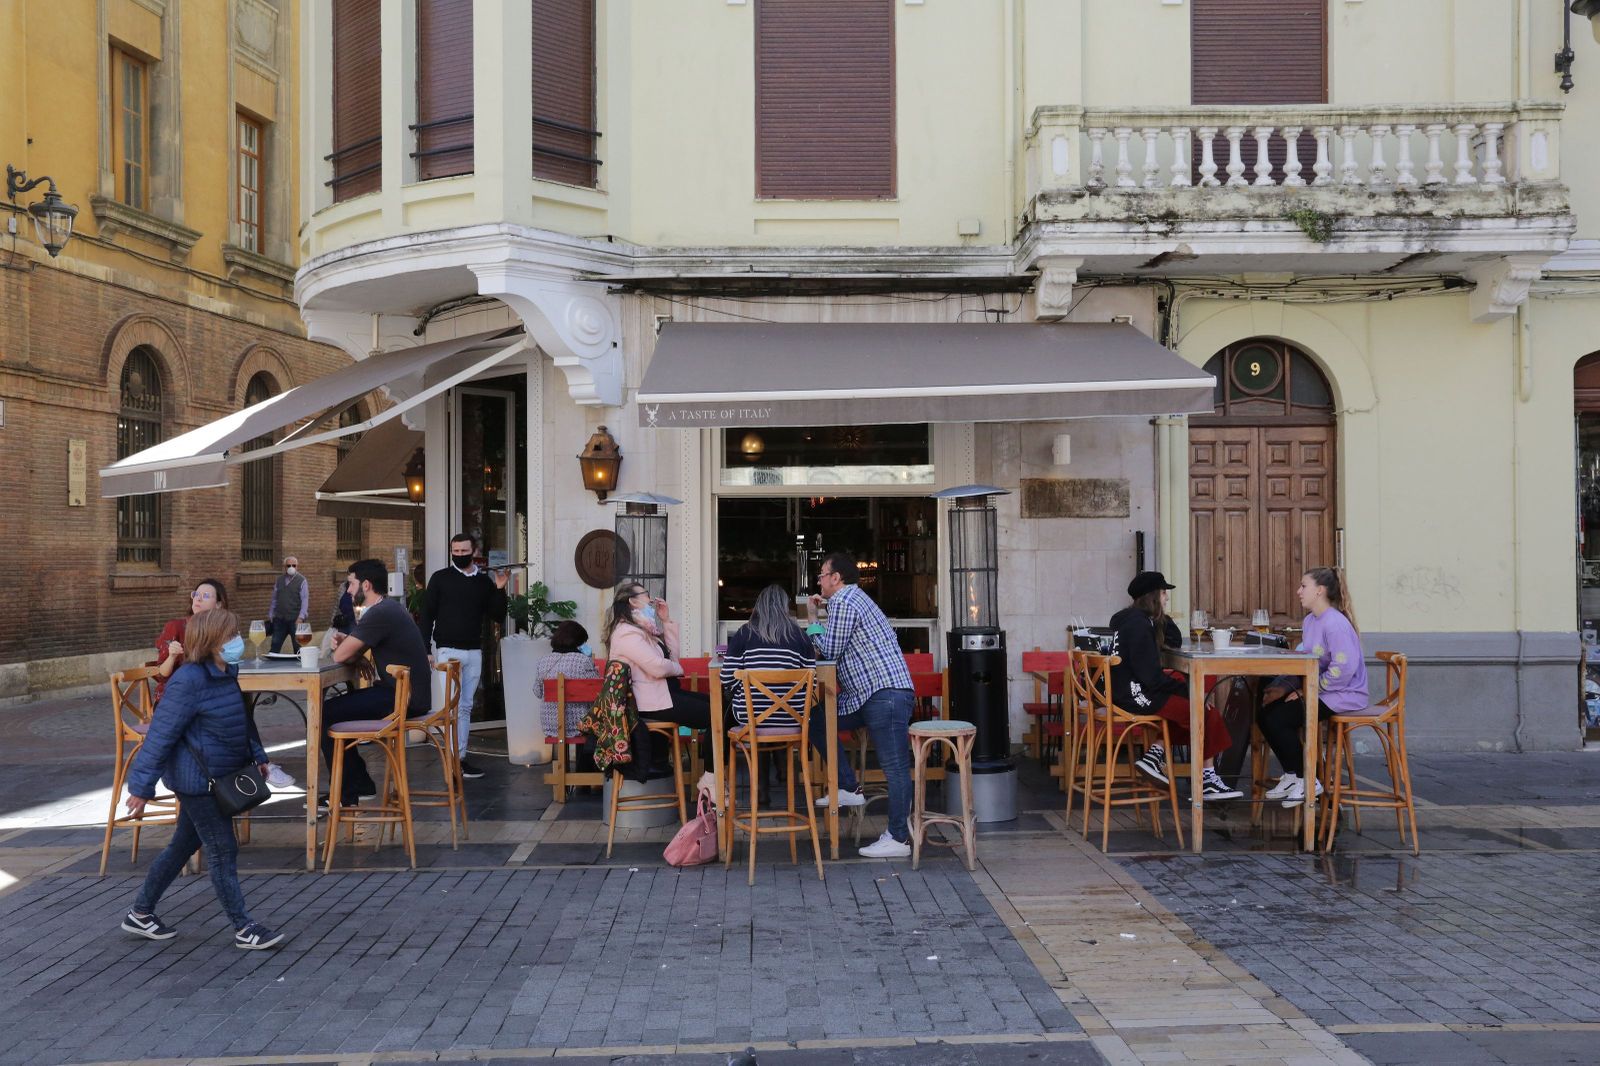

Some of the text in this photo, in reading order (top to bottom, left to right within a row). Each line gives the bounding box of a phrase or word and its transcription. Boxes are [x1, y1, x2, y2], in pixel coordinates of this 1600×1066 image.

[1250, 361, 1261, 376] 9
[669, 407, 772, 420] A TASTE OF ITALY
